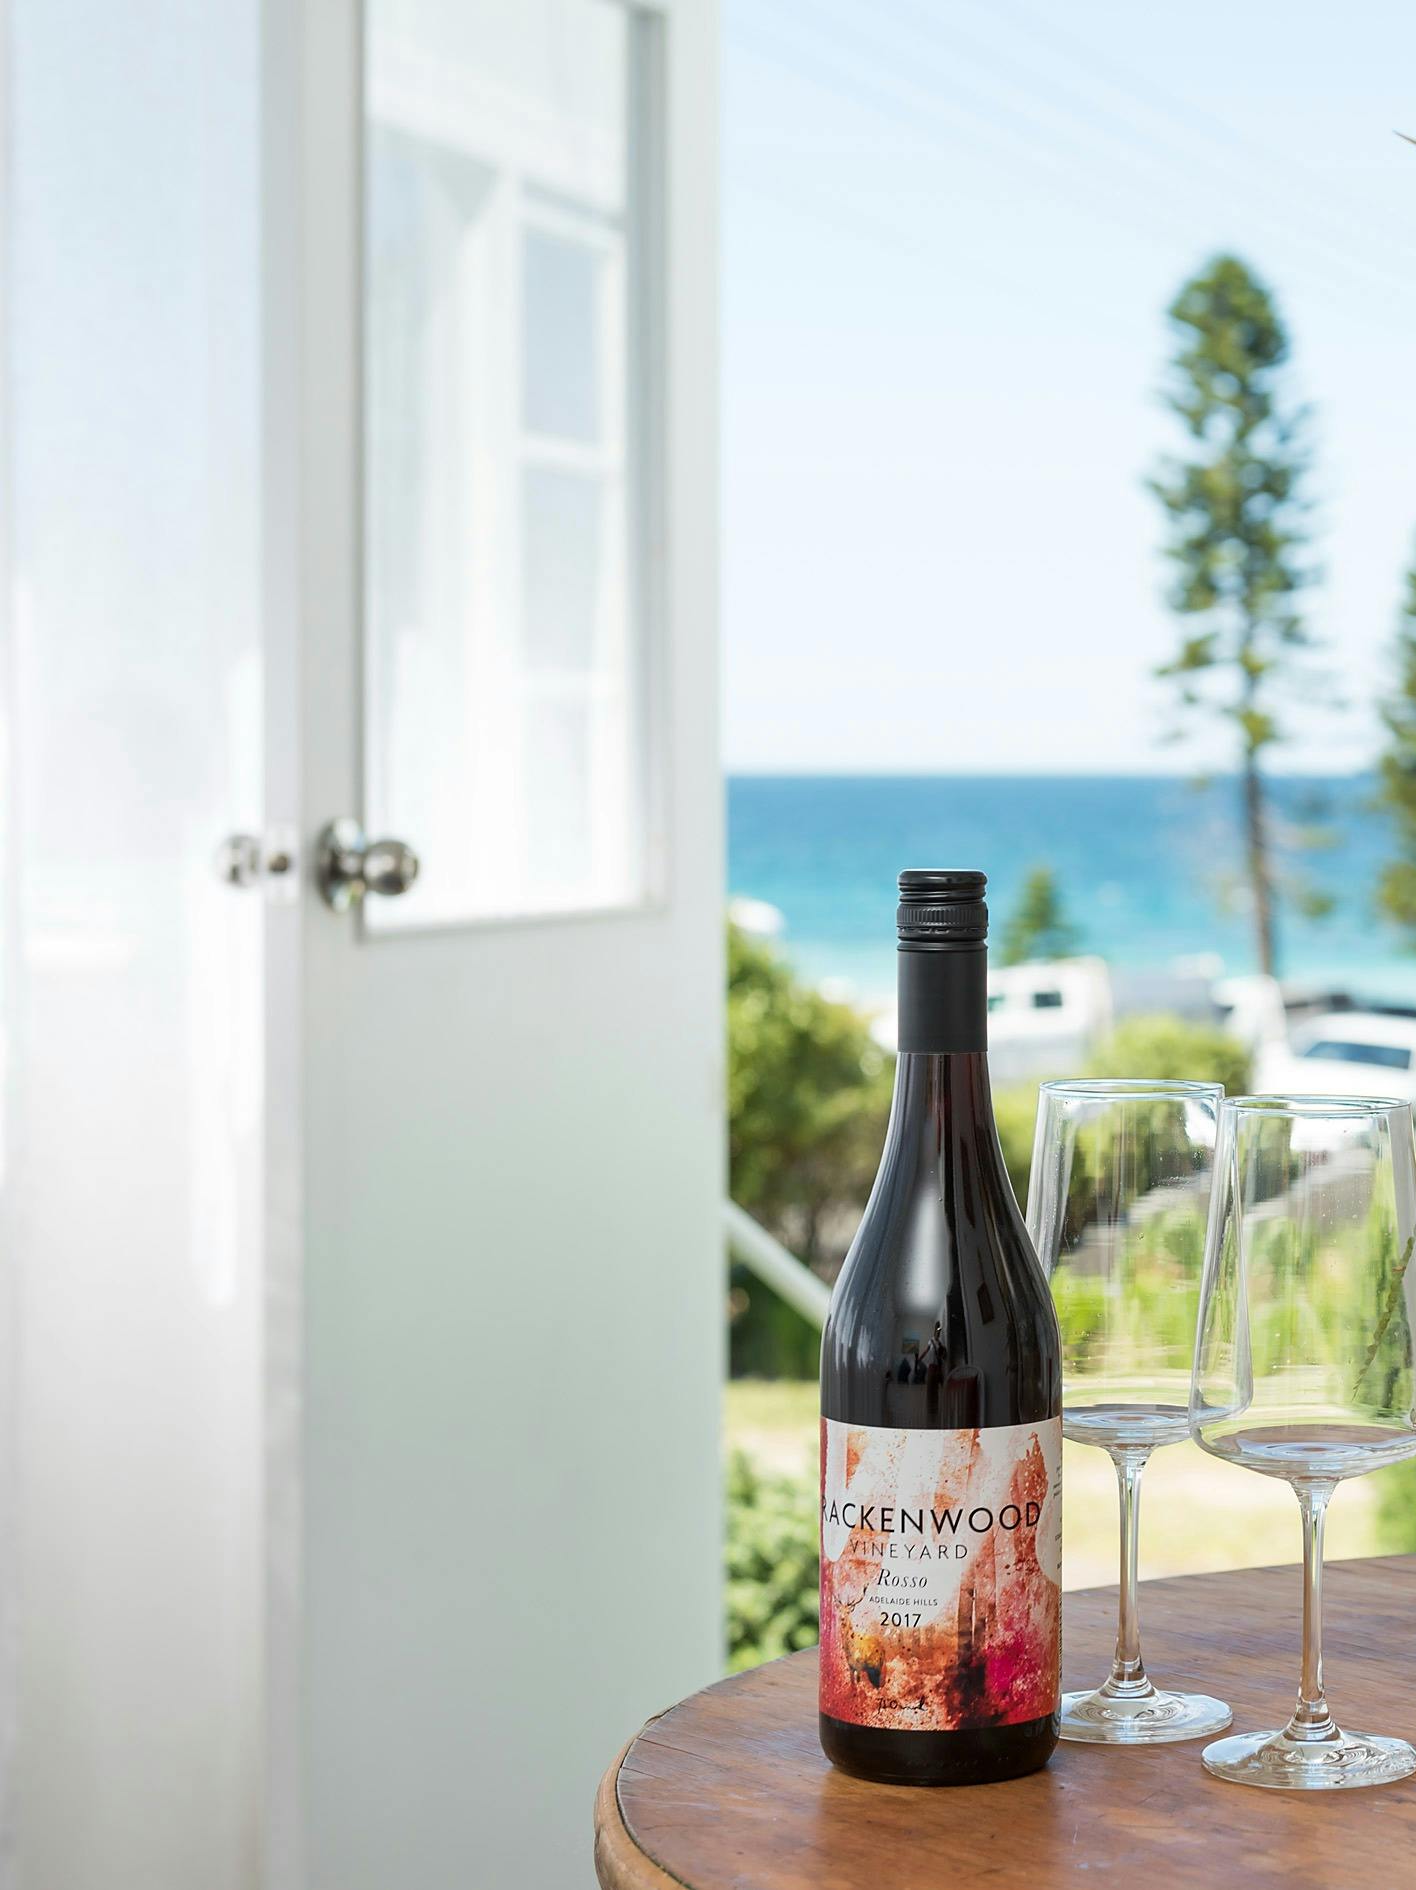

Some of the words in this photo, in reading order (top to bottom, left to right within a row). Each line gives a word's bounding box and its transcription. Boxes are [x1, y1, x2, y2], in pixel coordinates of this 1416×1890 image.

[850, 1539, 968, 1560] VINEYARD
[877, 1568, 928, 1588] Rosso
[869, 1595, 911, 1606] ADELAIDE
[912, 1598, 938, 1606] HILLS
[880, 1611, 921, 1628] 2017
